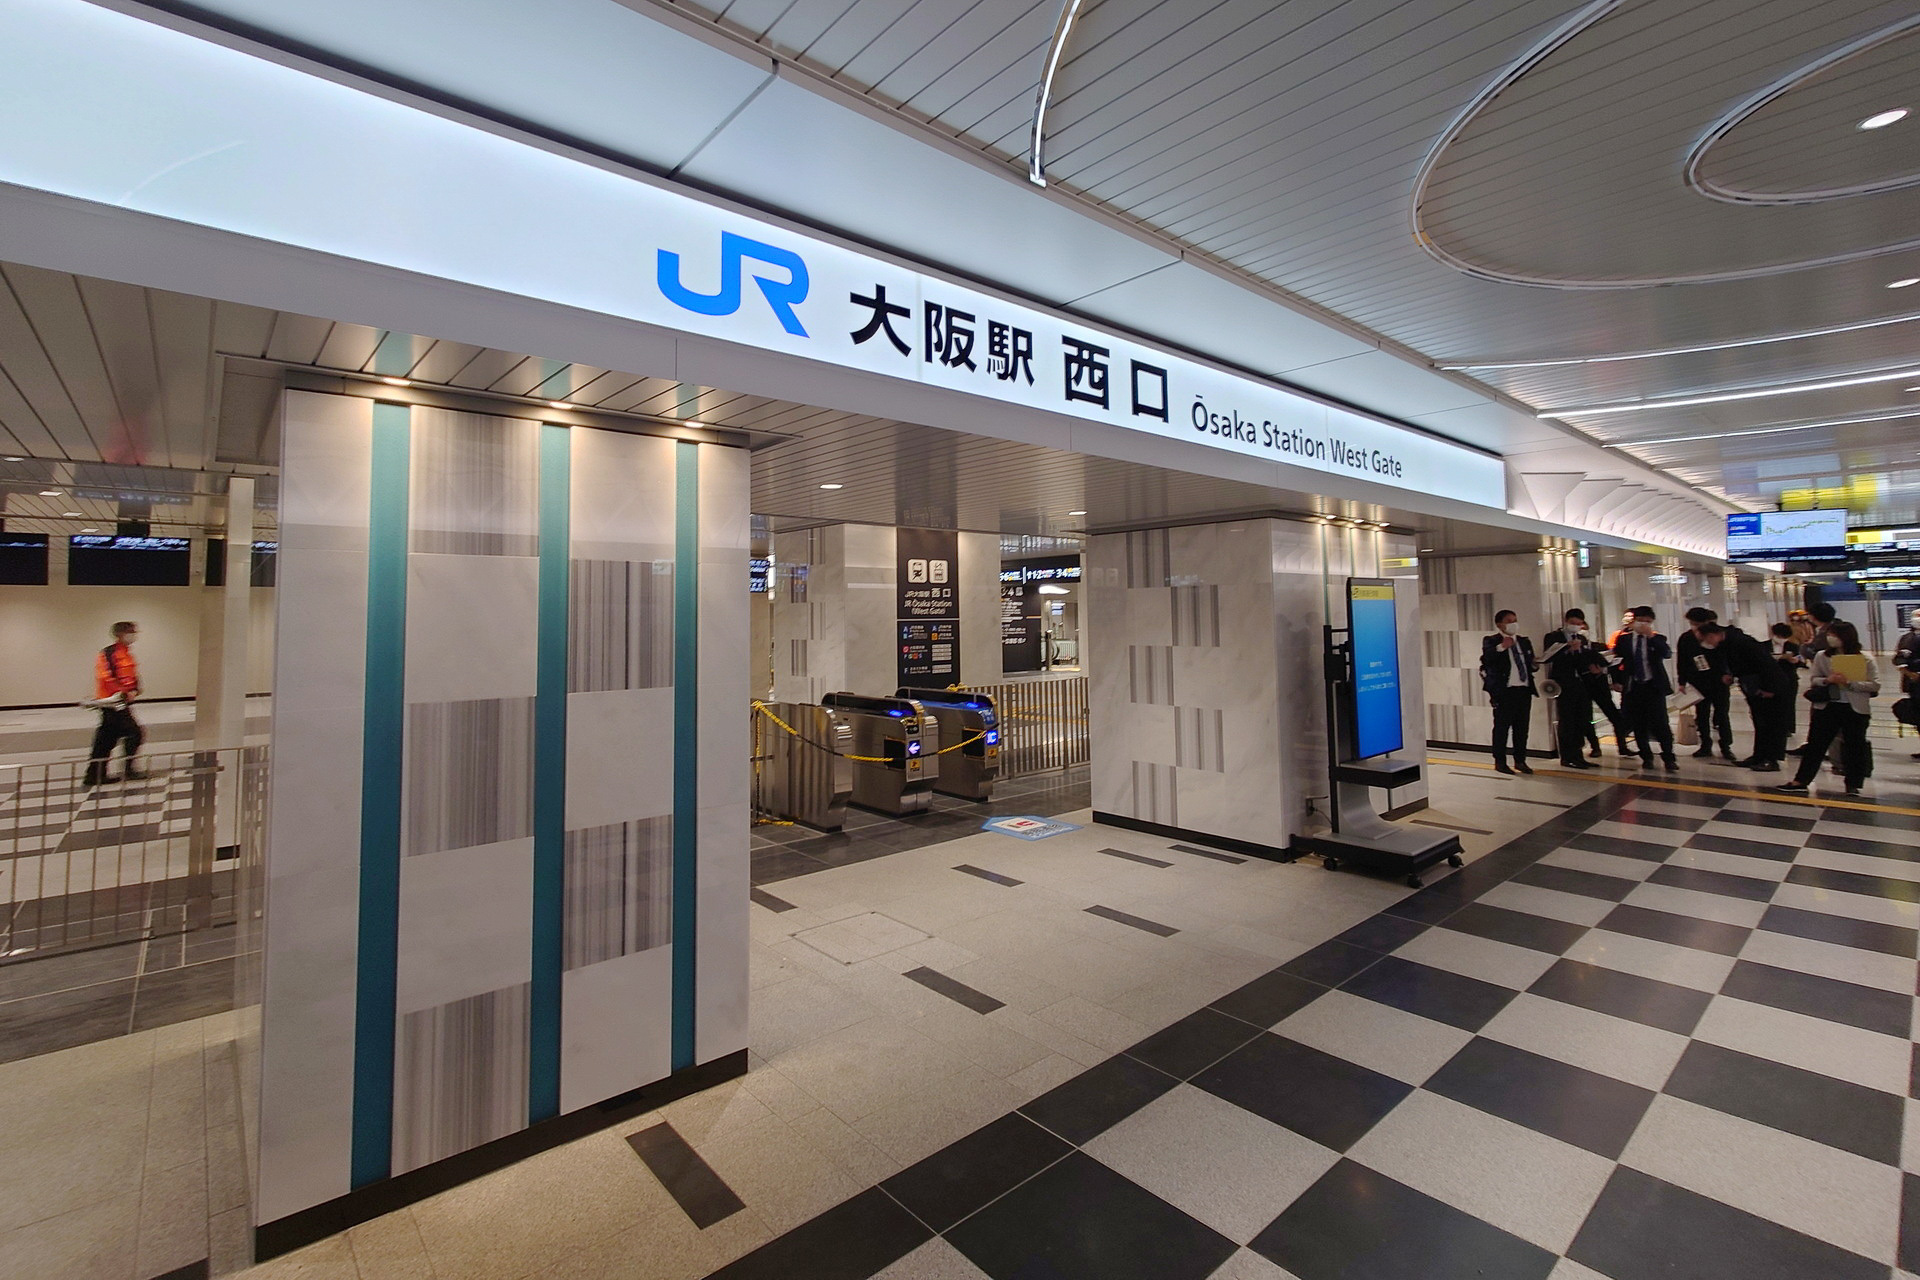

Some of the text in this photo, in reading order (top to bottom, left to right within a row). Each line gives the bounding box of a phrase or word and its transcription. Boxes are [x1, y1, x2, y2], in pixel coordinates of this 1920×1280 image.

[657, 231, 810, 338] JR
[851, 284, 1169, 424] 大阪駅 西口
[1191, 394, 1402, 478] Ōsaka Station West Gate
